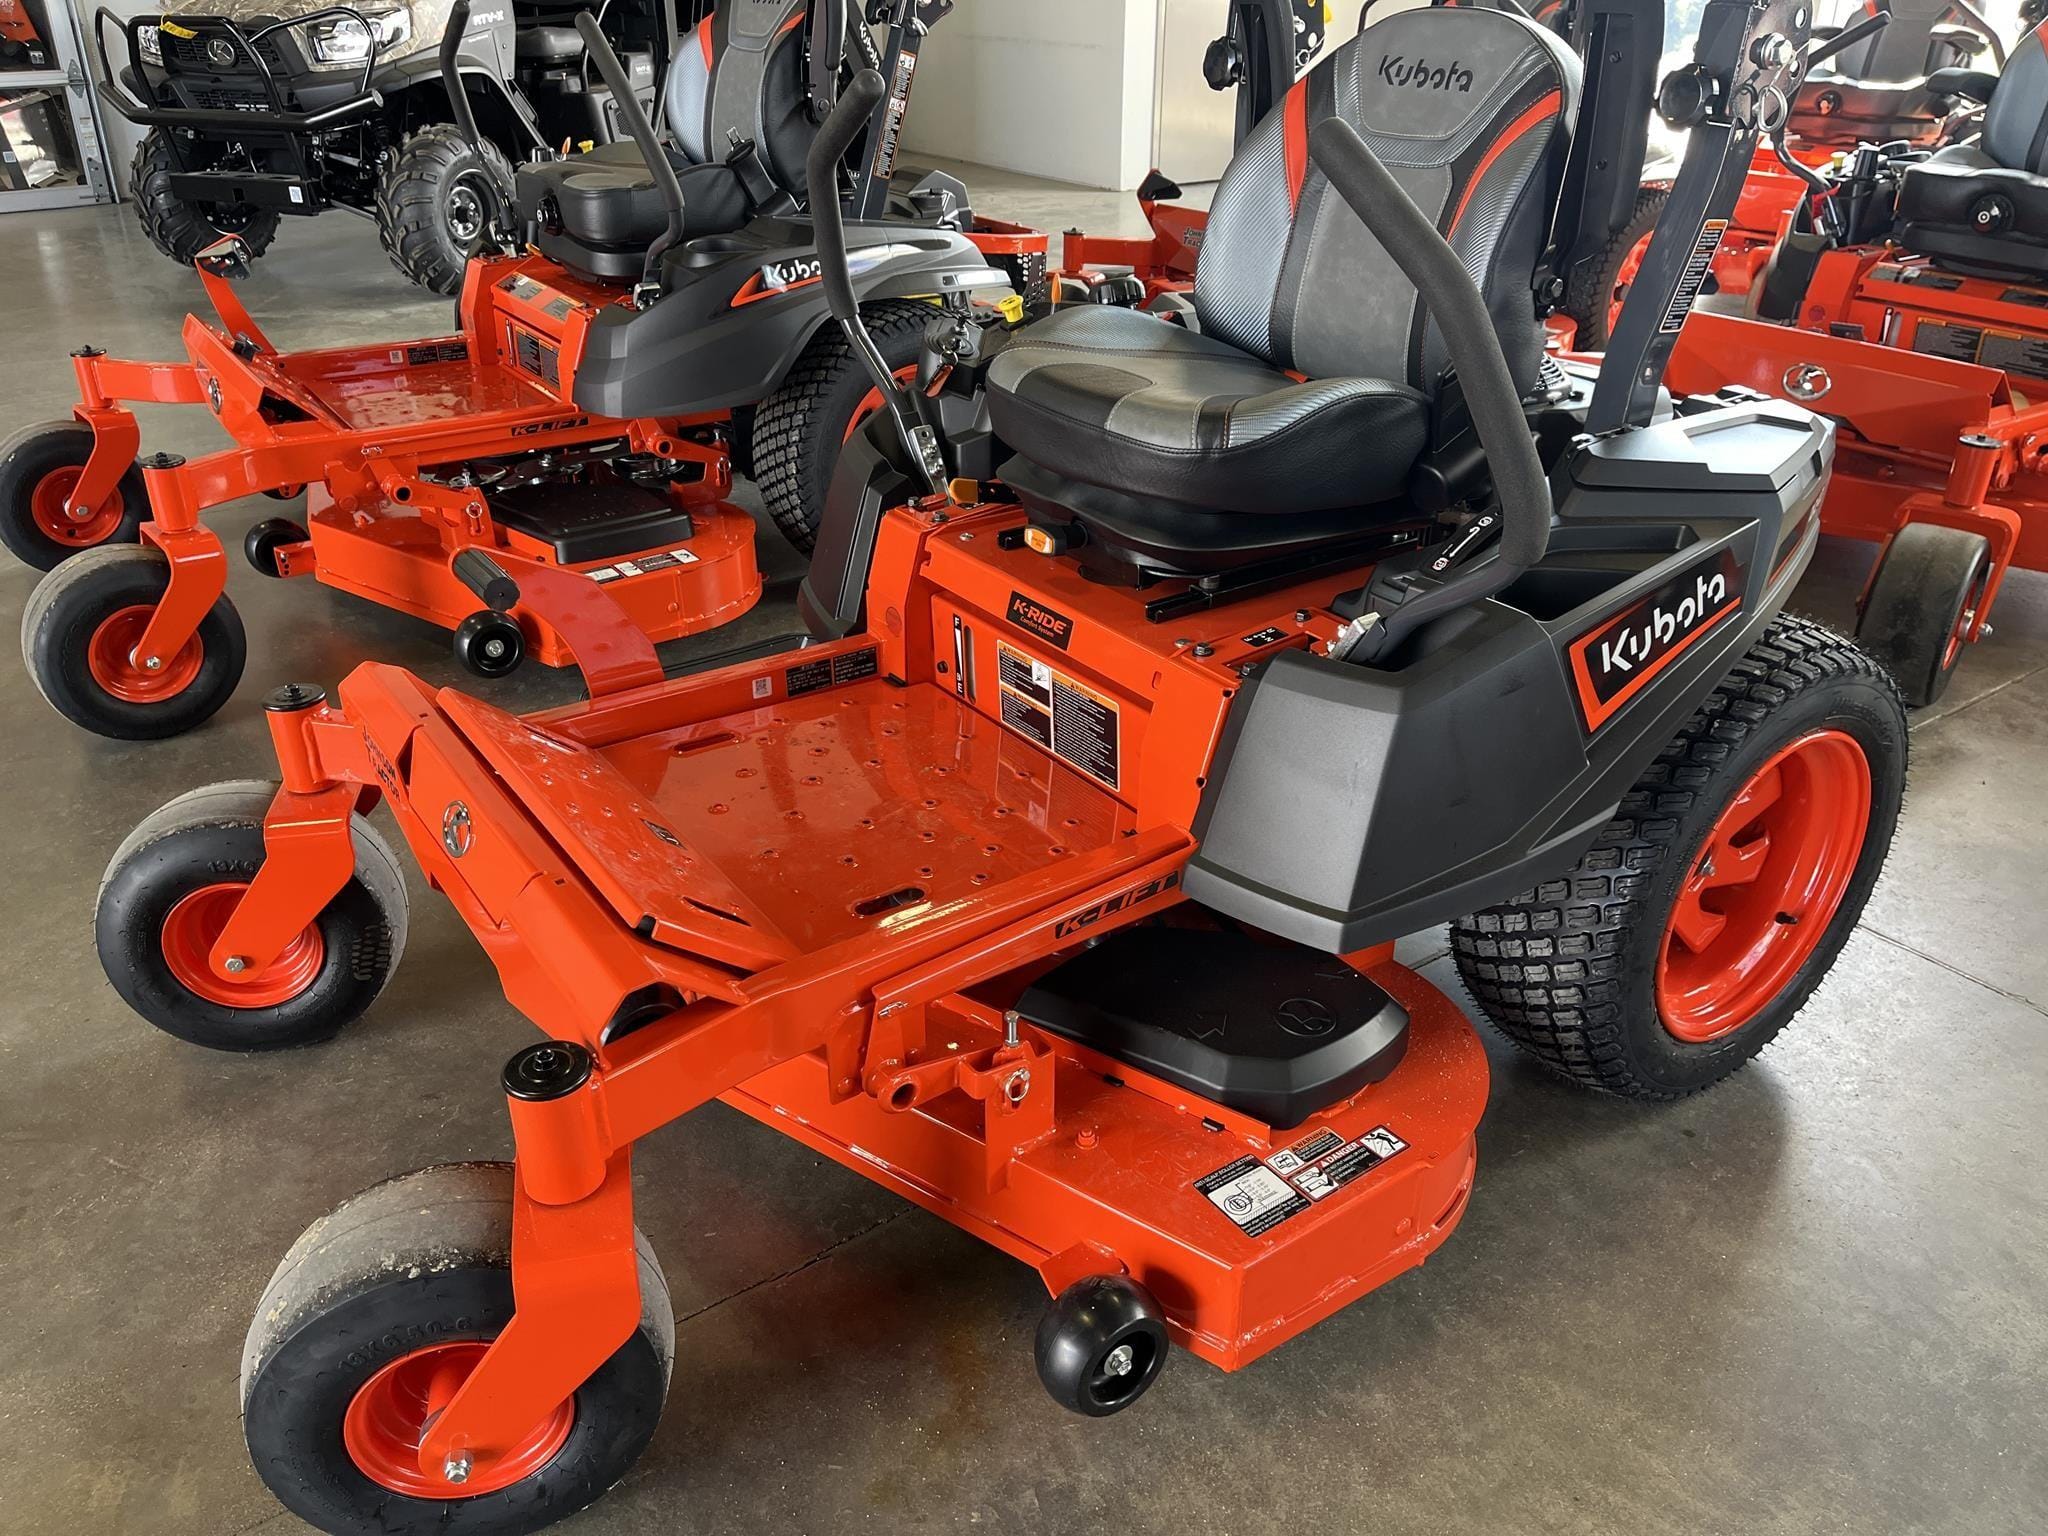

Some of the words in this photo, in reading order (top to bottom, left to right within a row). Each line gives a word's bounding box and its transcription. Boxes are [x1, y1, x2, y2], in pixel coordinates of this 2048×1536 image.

[1379, 55, 1473, 92] Kubota
[1013, 599, 1067, 635] K-RIDE
[1601, 573, 1725, 674] Kubota
[1060, 873, 1176, 937] K-LIFT
[1325, 1141, 1360, 1163] DANGER
